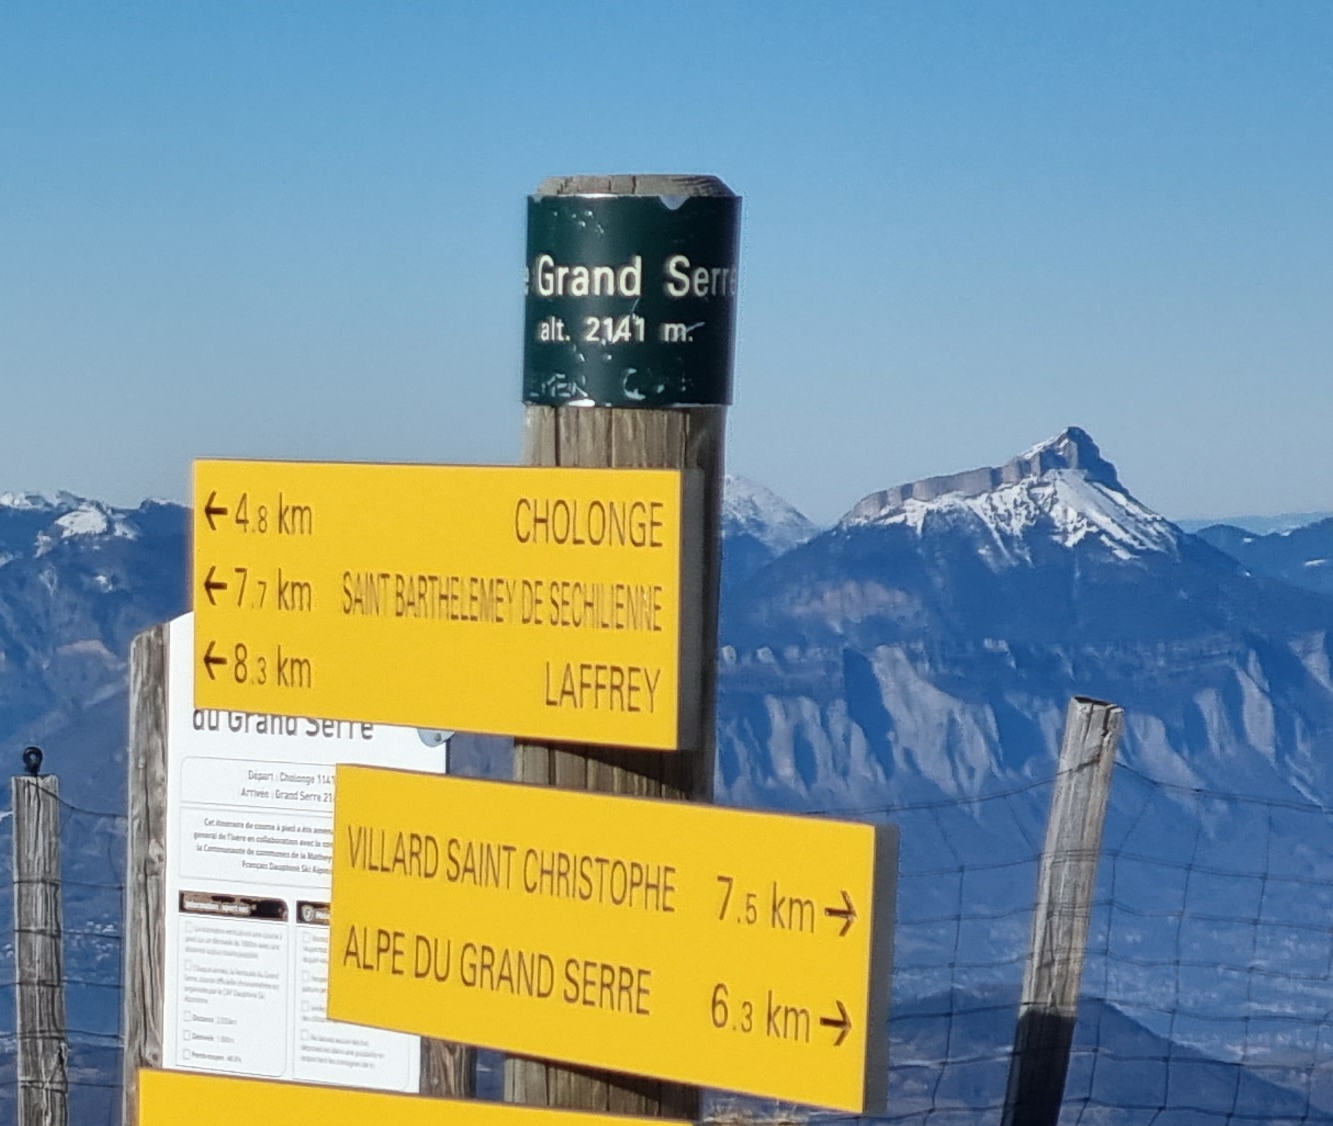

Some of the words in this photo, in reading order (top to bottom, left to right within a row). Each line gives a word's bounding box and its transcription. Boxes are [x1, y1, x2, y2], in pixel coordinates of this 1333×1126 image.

[537, 254, 642, 297] Grand
[540, 316, 571, 342] alt.
[586, 316, 645, 342] 2141
[234, 492, 268, 534] 4.8
[278, 492, 313, 536] km
[515, 498, 664, 548] CHOLONGE
[234, 567, 267, 609] 7.7
[278, 568, 312, 612] km
[343, 570, 390, 616] SAINT
[395, 573, 516, 623] BARTHELEMEY
[521, 579, 544, 625] DE
[550, 580, 663, 631] SECHILIENNE
[234, 643, 267, 686] 8.3
[278, 645, 312, 688] km
[546, 661, 661, 714] LAFFREY
[300, 791, 321, 802] Serre
[348, 824, 440, 880] VILLARD
[446, 837, 517, 891] SAINT
[523, 848, 677, 914] CHRISTOPHE
[716, 875, 758, 926] 7.5
[771, 881, 816, 935] km
[343, 925, 405, 976] ALPE
[414, 933, 451, 983] DU
[460, 941, 555, 999] GRAND
[563, 958, 652, 1016] SERRE
[711, 983, 753, 1032] 6.3
[767, 990, 810, 1043] km
